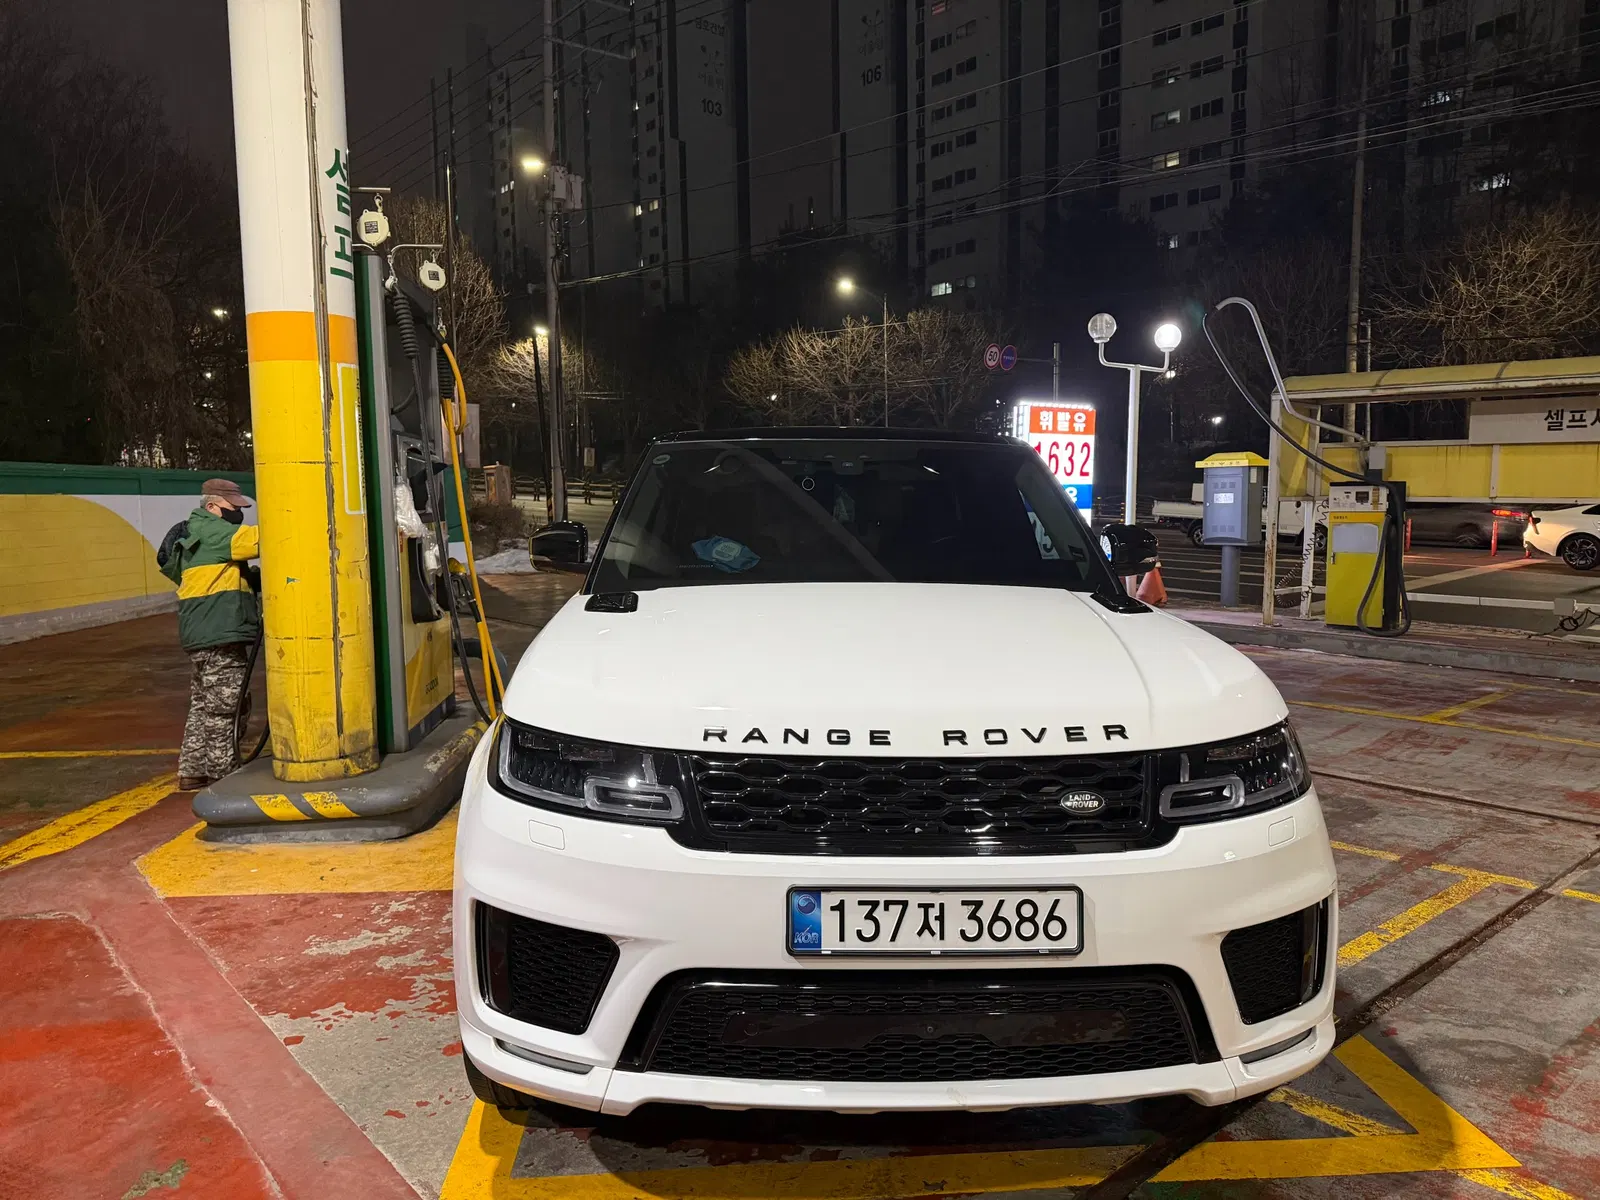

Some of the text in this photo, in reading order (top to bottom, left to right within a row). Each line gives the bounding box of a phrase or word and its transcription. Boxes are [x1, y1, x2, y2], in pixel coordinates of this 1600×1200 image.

[861, 65, 882, 87] 106
[701, 98, 723, 117] 103
[987, 350, 998, 362] 50
[1039, 410, 1087, 433] 휘발유
[702, 724, 1130, 746] RANGE ROVER
[1072, 800, 1098, 808] ROVER
[959, 898, 1068, 943] 3686
[794, 930, 819, 944] KOR
